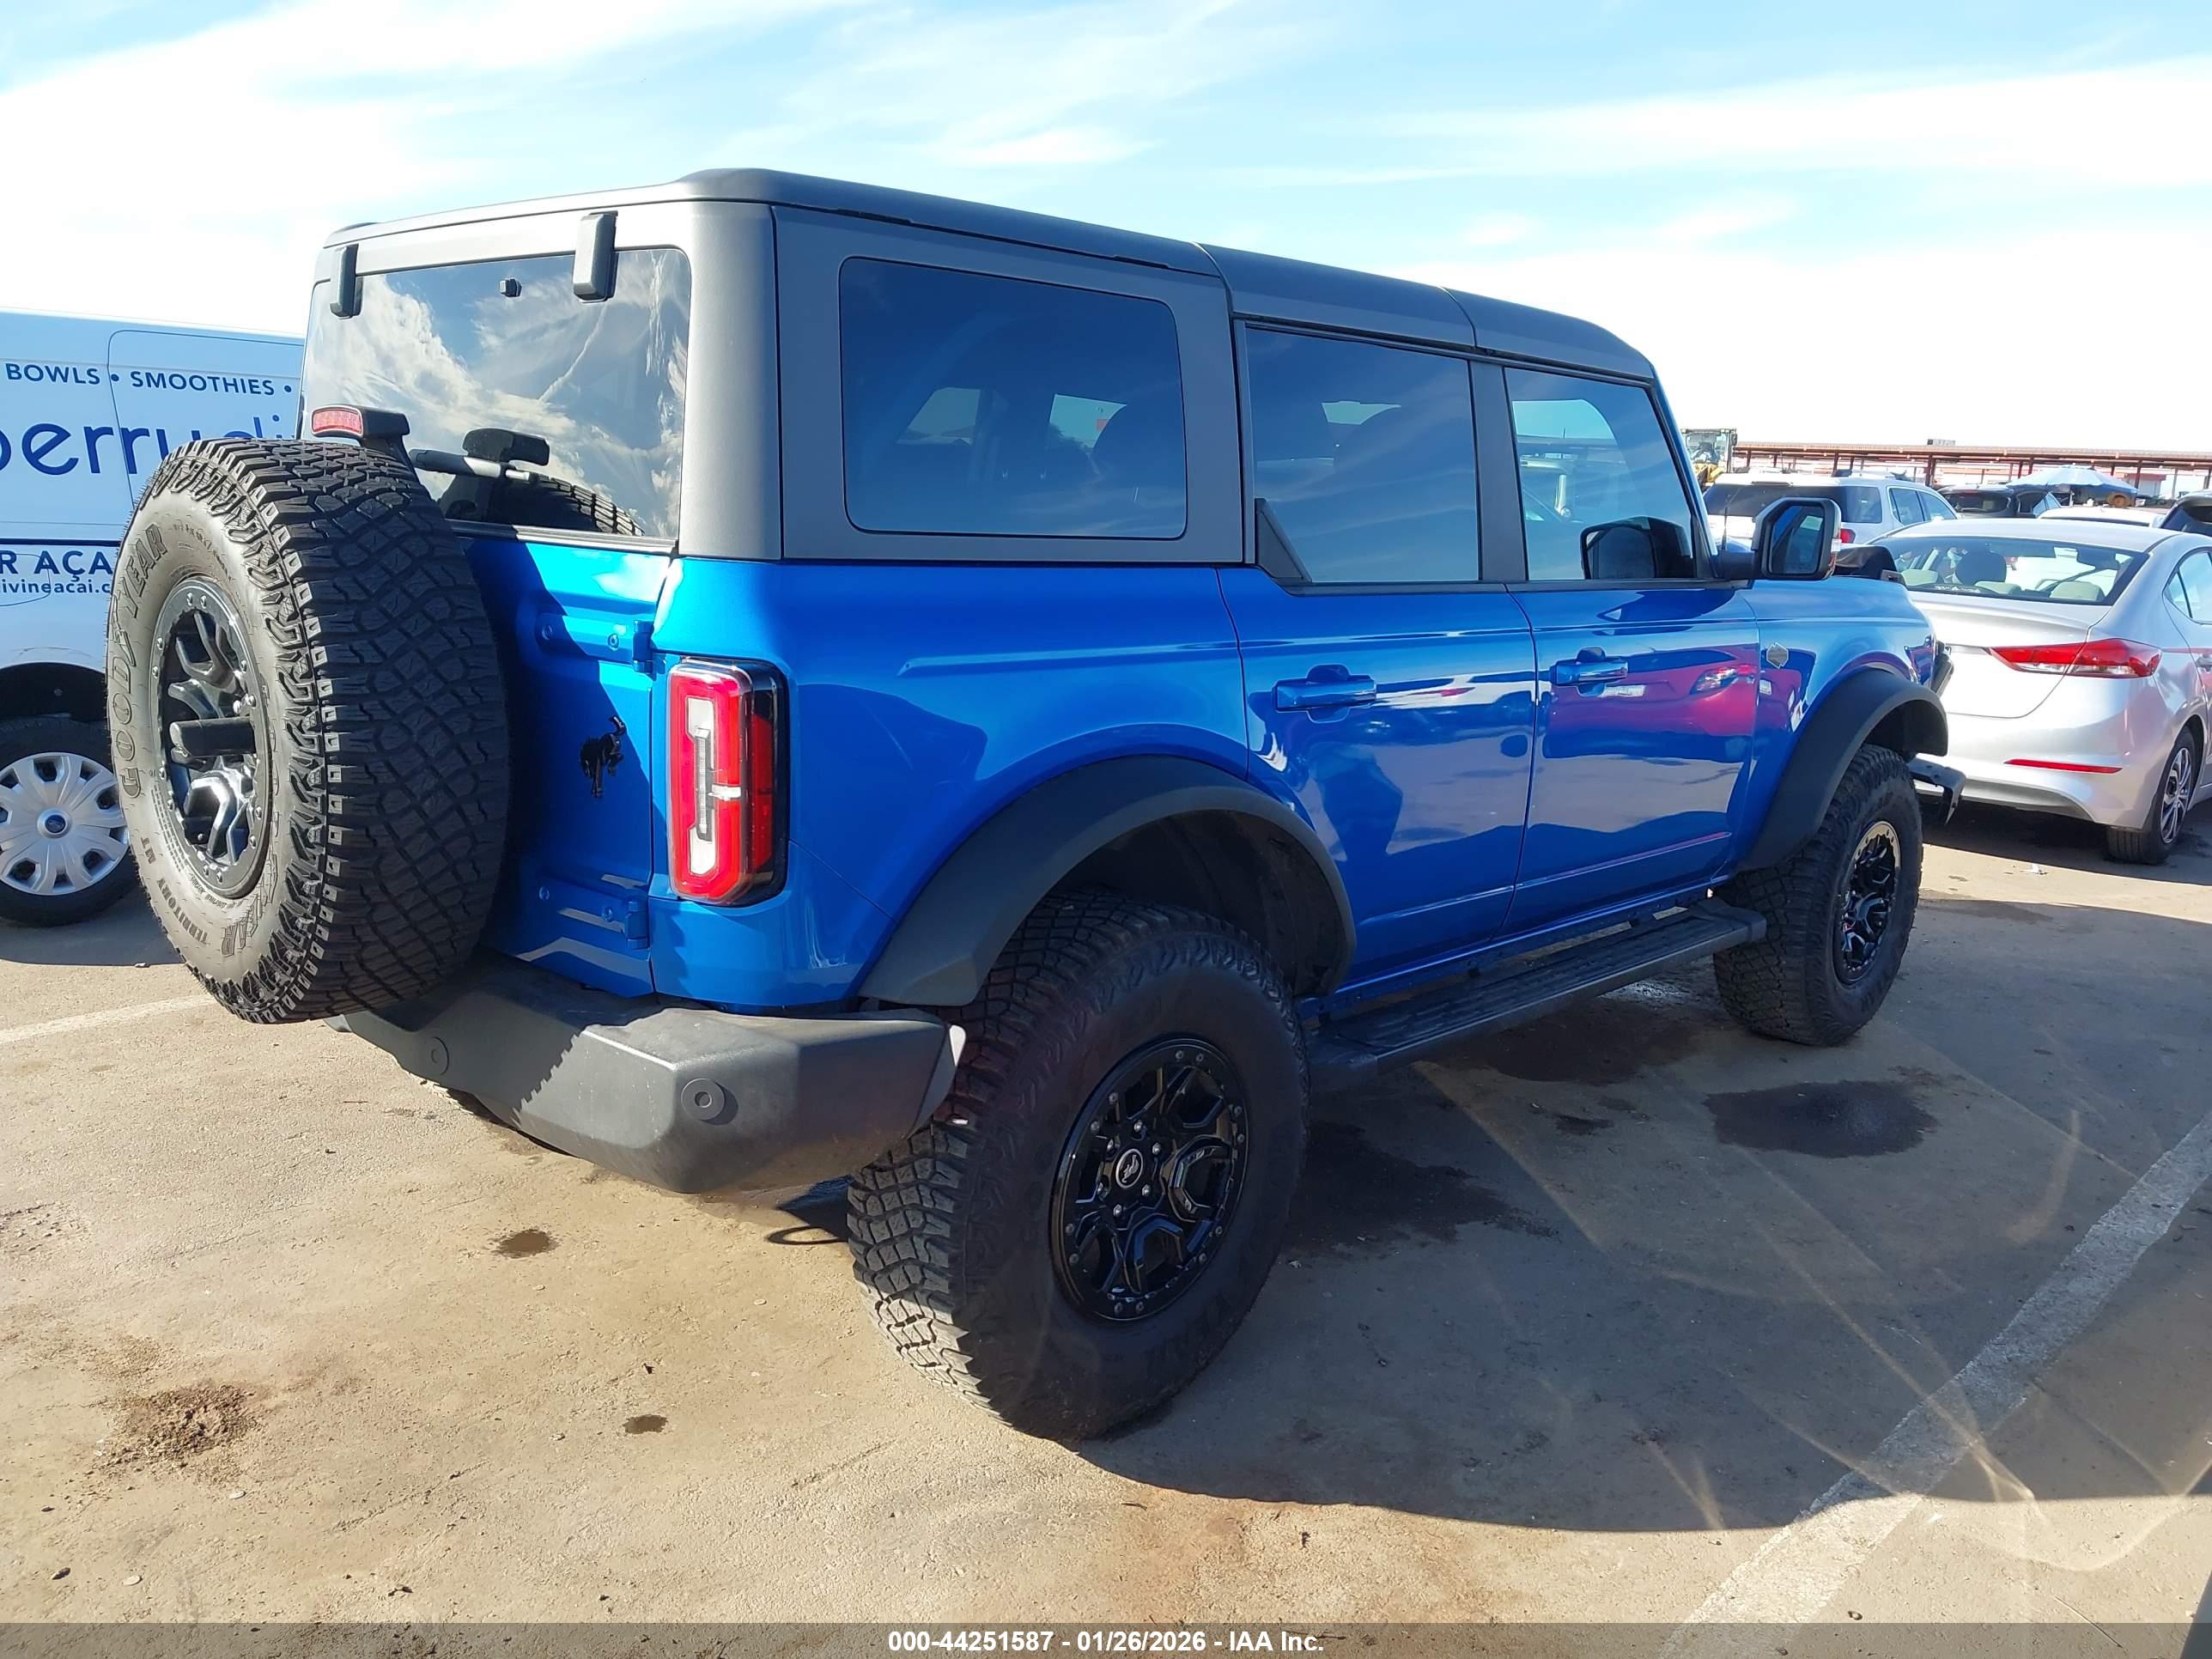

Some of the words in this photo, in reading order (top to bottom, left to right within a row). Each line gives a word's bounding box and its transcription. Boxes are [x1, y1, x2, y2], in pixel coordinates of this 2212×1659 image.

[5, 362, 100, 385] BOWLS
[131, 371, 275, 396] SMOOTHIES
[156, 878, 209, 945] TERRITORY
